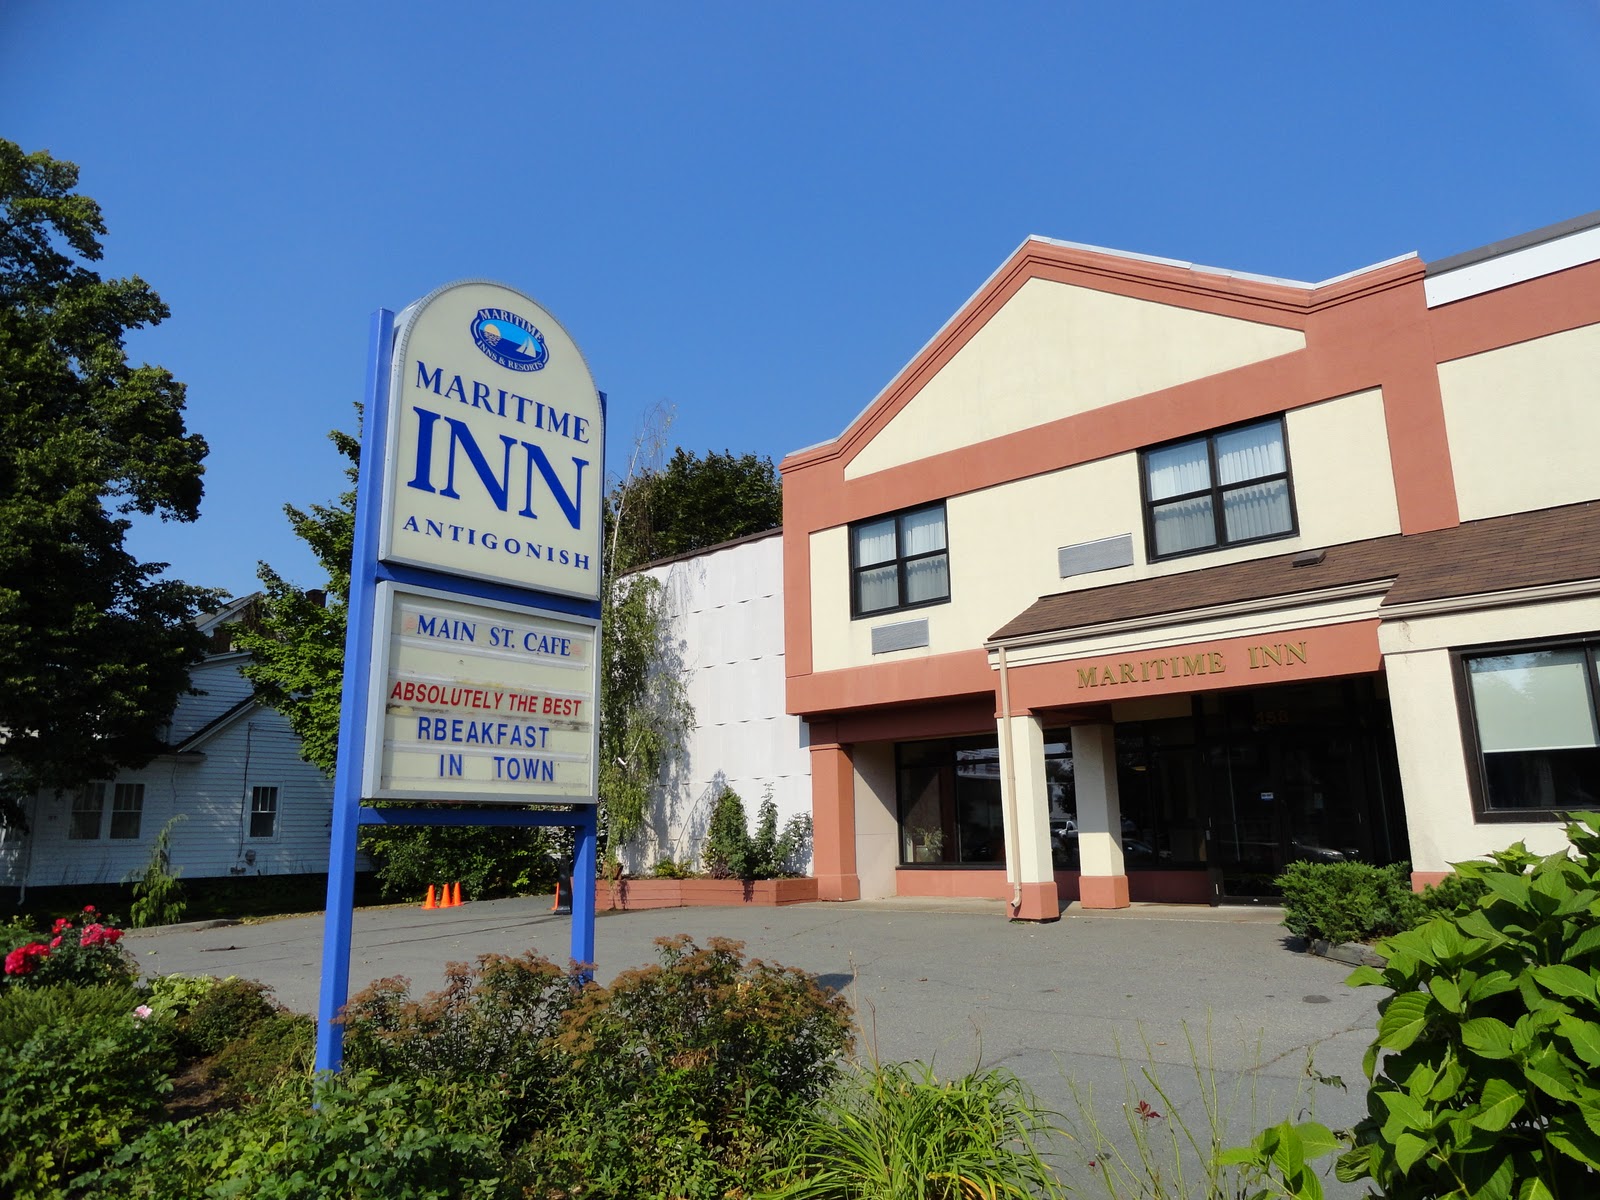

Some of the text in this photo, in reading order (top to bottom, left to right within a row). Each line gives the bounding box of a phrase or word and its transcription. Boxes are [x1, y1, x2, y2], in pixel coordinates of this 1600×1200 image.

[479, 309, 544, 342] MARITIME
[477, 340, 544, 371] INNS & RESORTS
[416, 360, 590, 444] MARITIME
[407, 405, 590, 530] INN
[403, 515, 590, 570] ANTIGONISH
[417, 614, 571, 656] MAIN ST. CAFE
[1076, 641, 1308, 688] MARITIME INN
[391, 681, 582, 716] ABSOLUTELY THE BEST
[417, 716, 550, 749] RBEAKFAST
[439, 753, 554, 782] IN TOWN
